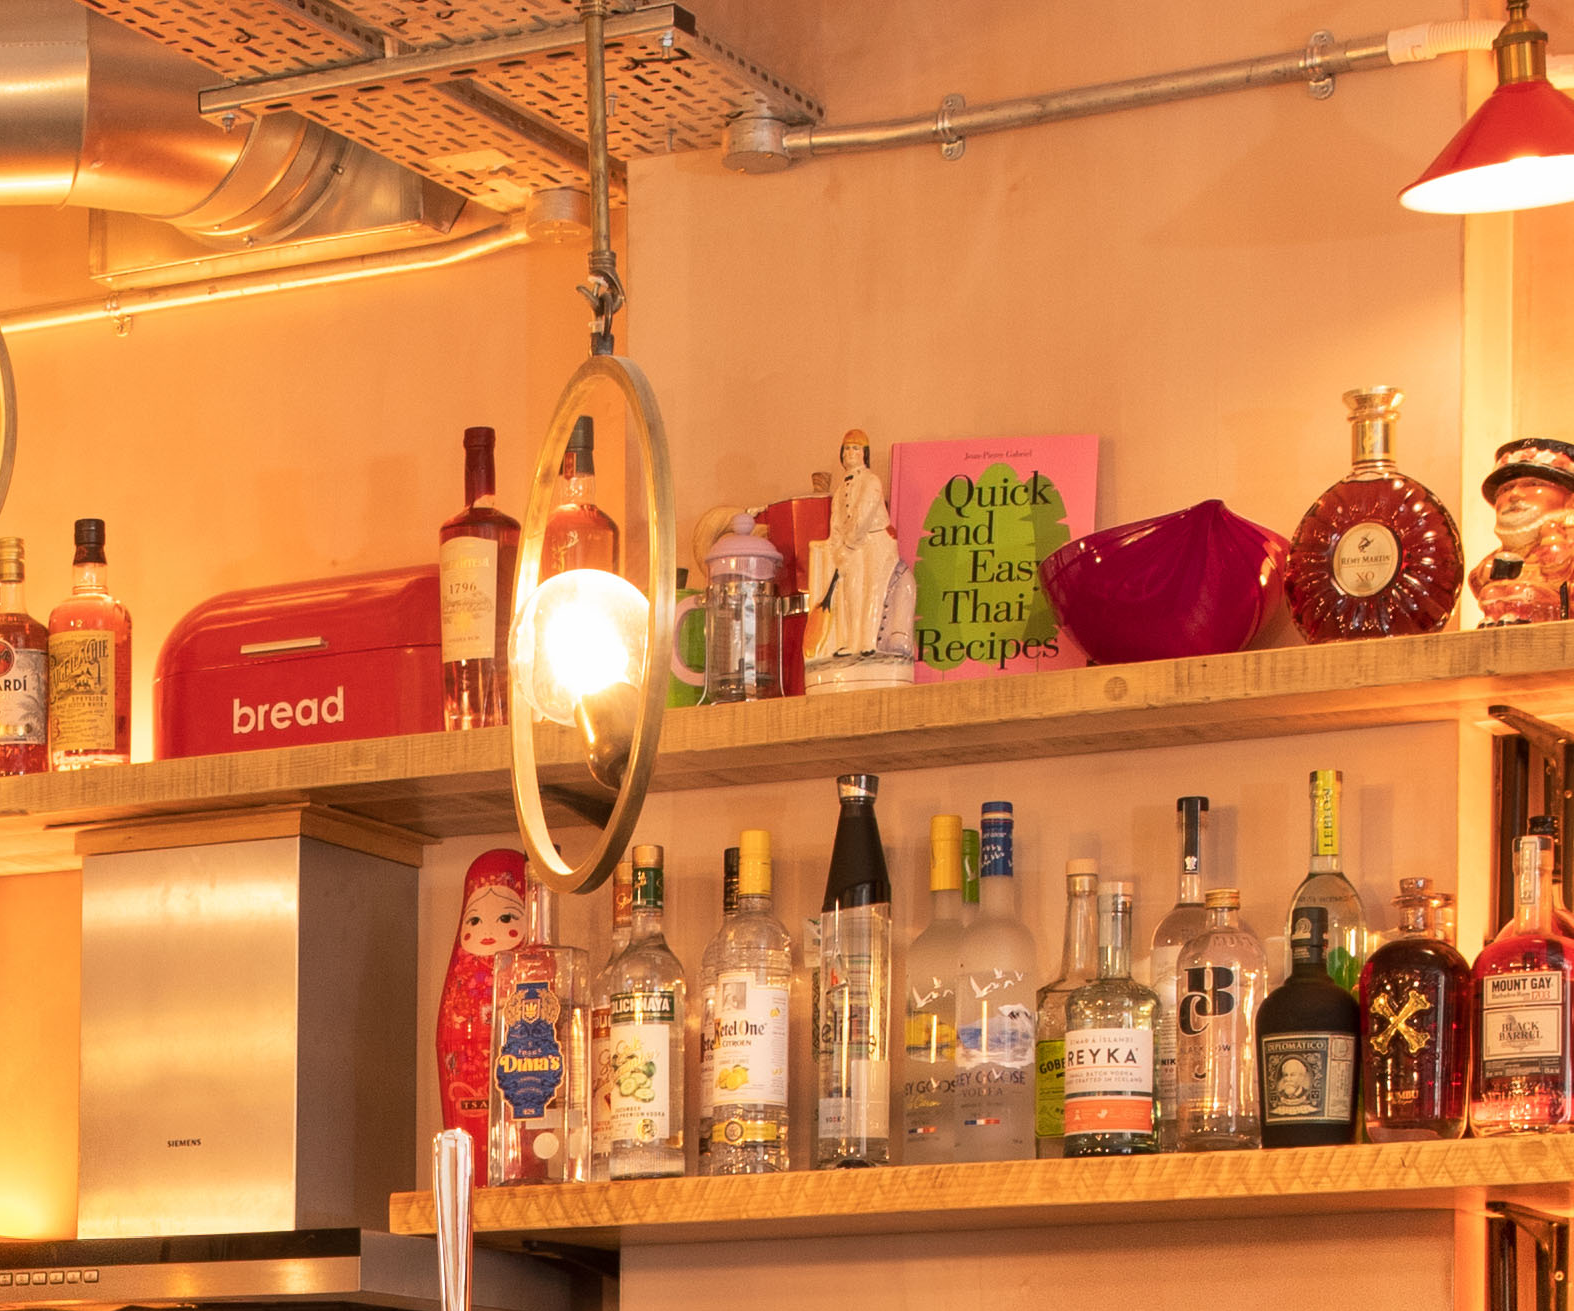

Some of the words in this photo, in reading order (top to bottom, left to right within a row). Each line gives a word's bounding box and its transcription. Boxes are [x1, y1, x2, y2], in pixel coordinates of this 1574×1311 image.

[945, 470, 1052, 518] Quick
[928, 510, 994, 547] and
[449, 582, 477, 594] 1796
[942, 588, 1027, 625] Thai
[915, 627, 1060, 670] Recipes
[233, 685, 344, 734] bread
[1492, 979, 1528, 993] MOUNT
[1530, 977, 1552, 990] GAY
[738, 1019, 766, 1037] One
[1499, 1030, 1543, 1041] BARREL
[1502, 1021, 1540, 1032] BLACK
[1067, 1048, 1137, 1067] REYKA
[167, 1138, 201, 1148] SIEMENS
